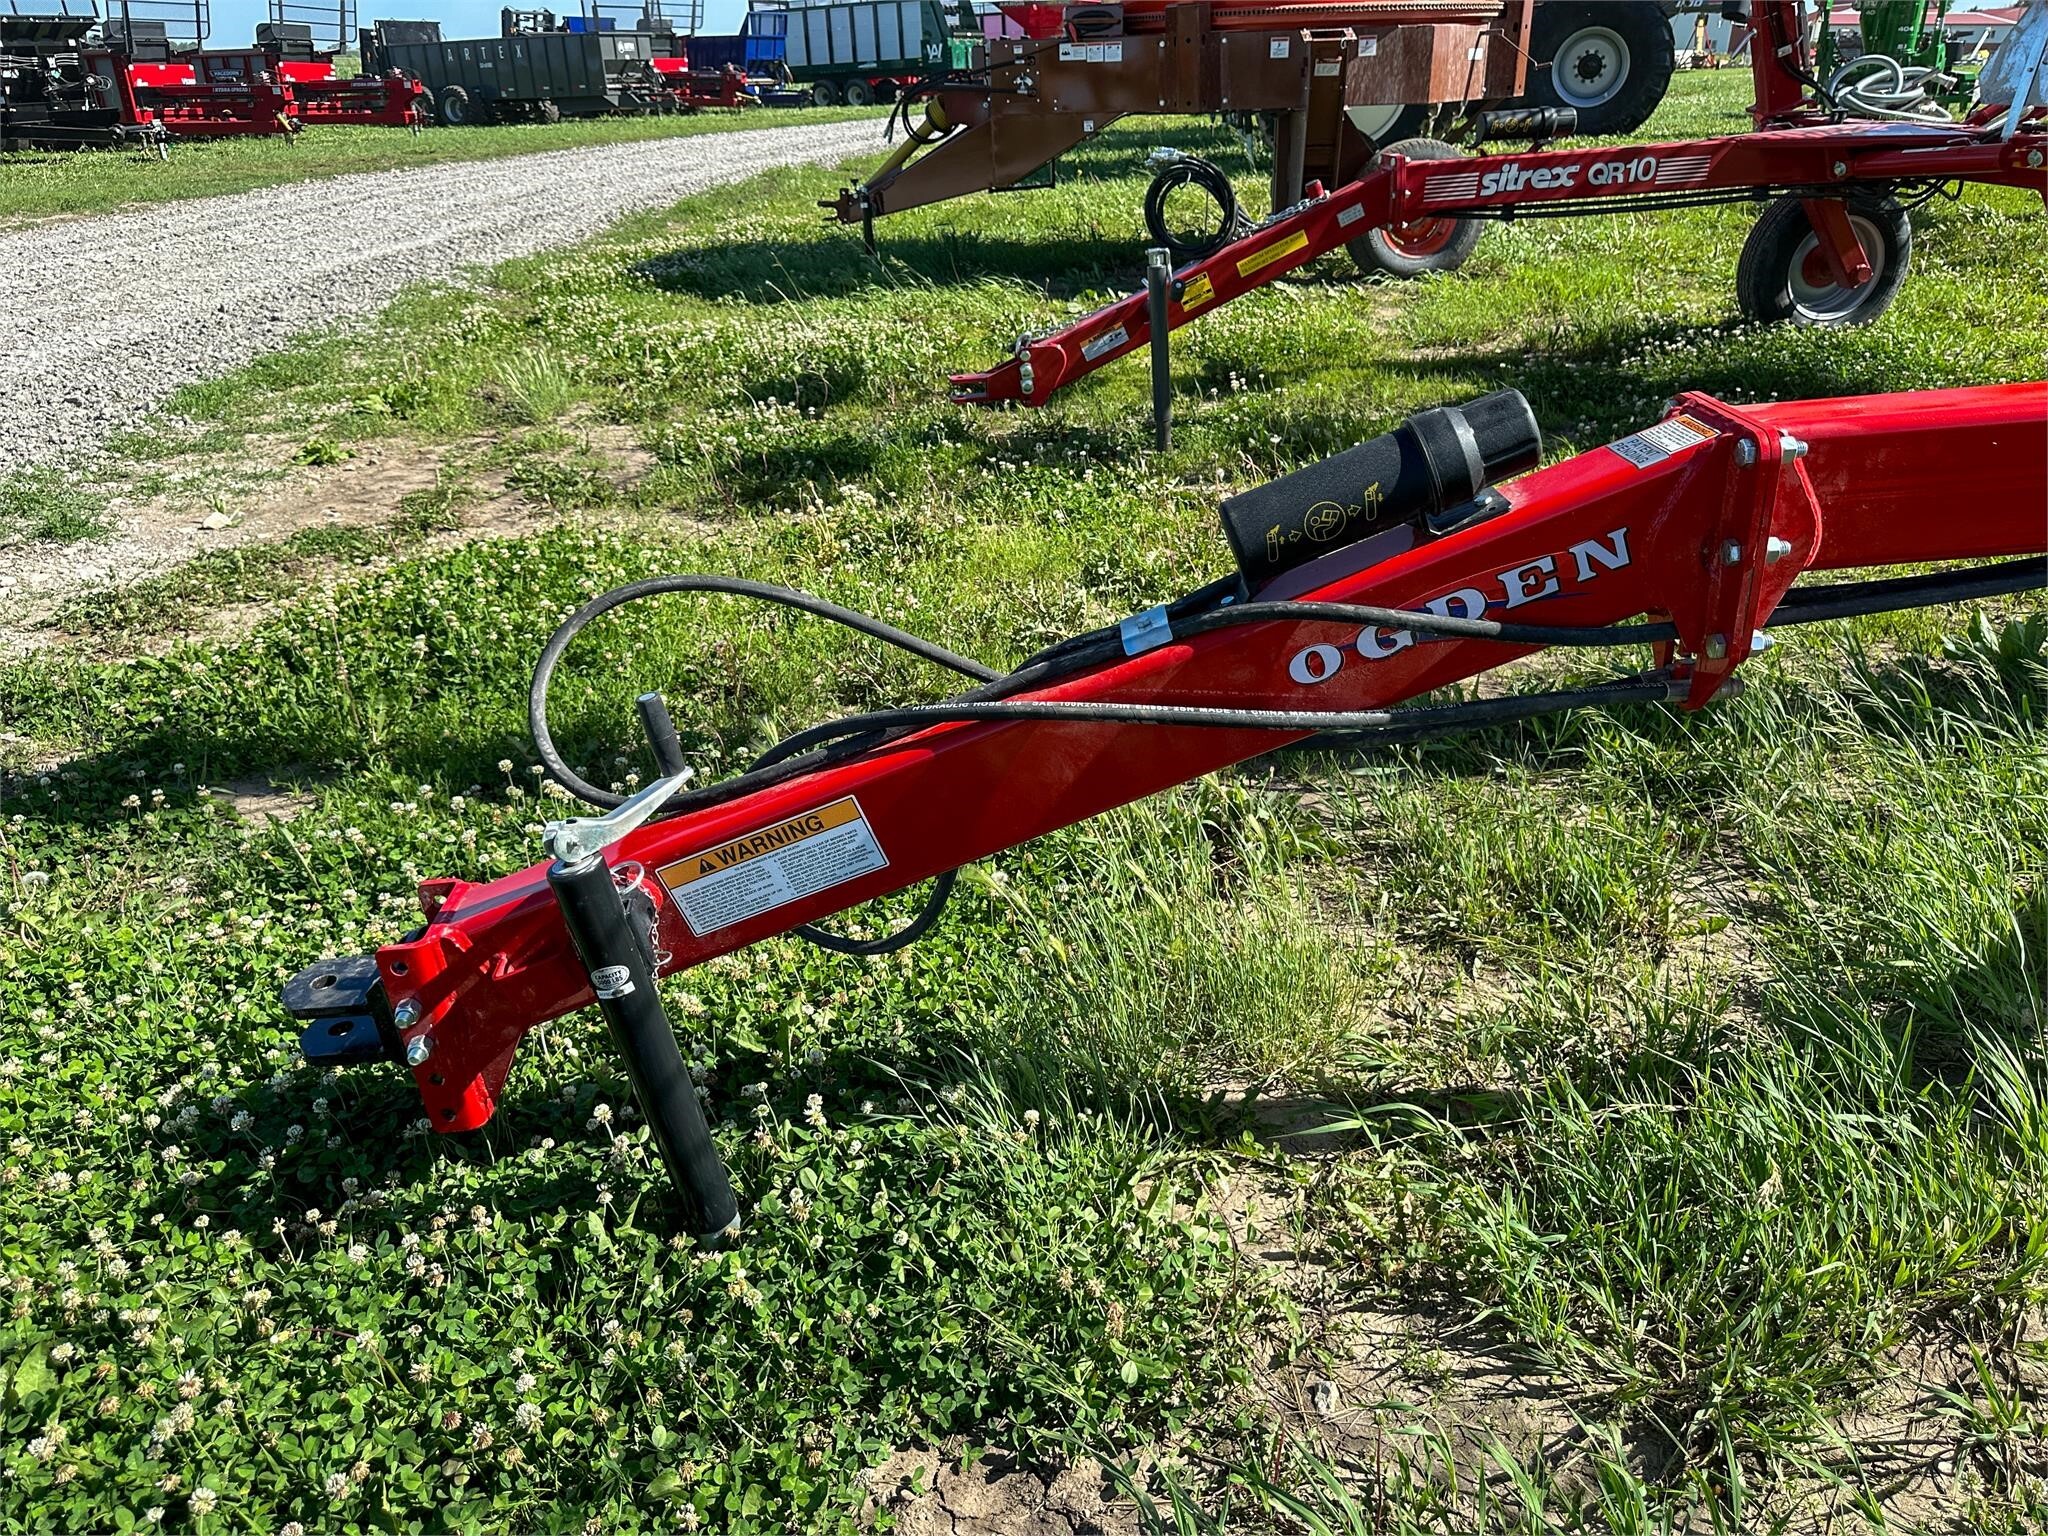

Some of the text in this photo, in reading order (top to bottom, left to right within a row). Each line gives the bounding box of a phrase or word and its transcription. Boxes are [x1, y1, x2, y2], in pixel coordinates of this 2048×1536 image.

[447, 44, 523, 62] ARTEX
[1480, 156, 1657, 197] sitrex QR10
[1615, 442, 1649, 464] PENDING
[1628, 437, 1661, 458] PATENT
[1288, 526, 1632, 685] OGDEN
[912, 702, 969, 711] HYDRAULIC
[714, 816, 825, 866] WARNING
[595, 970, 622, 980] CAPACITY
